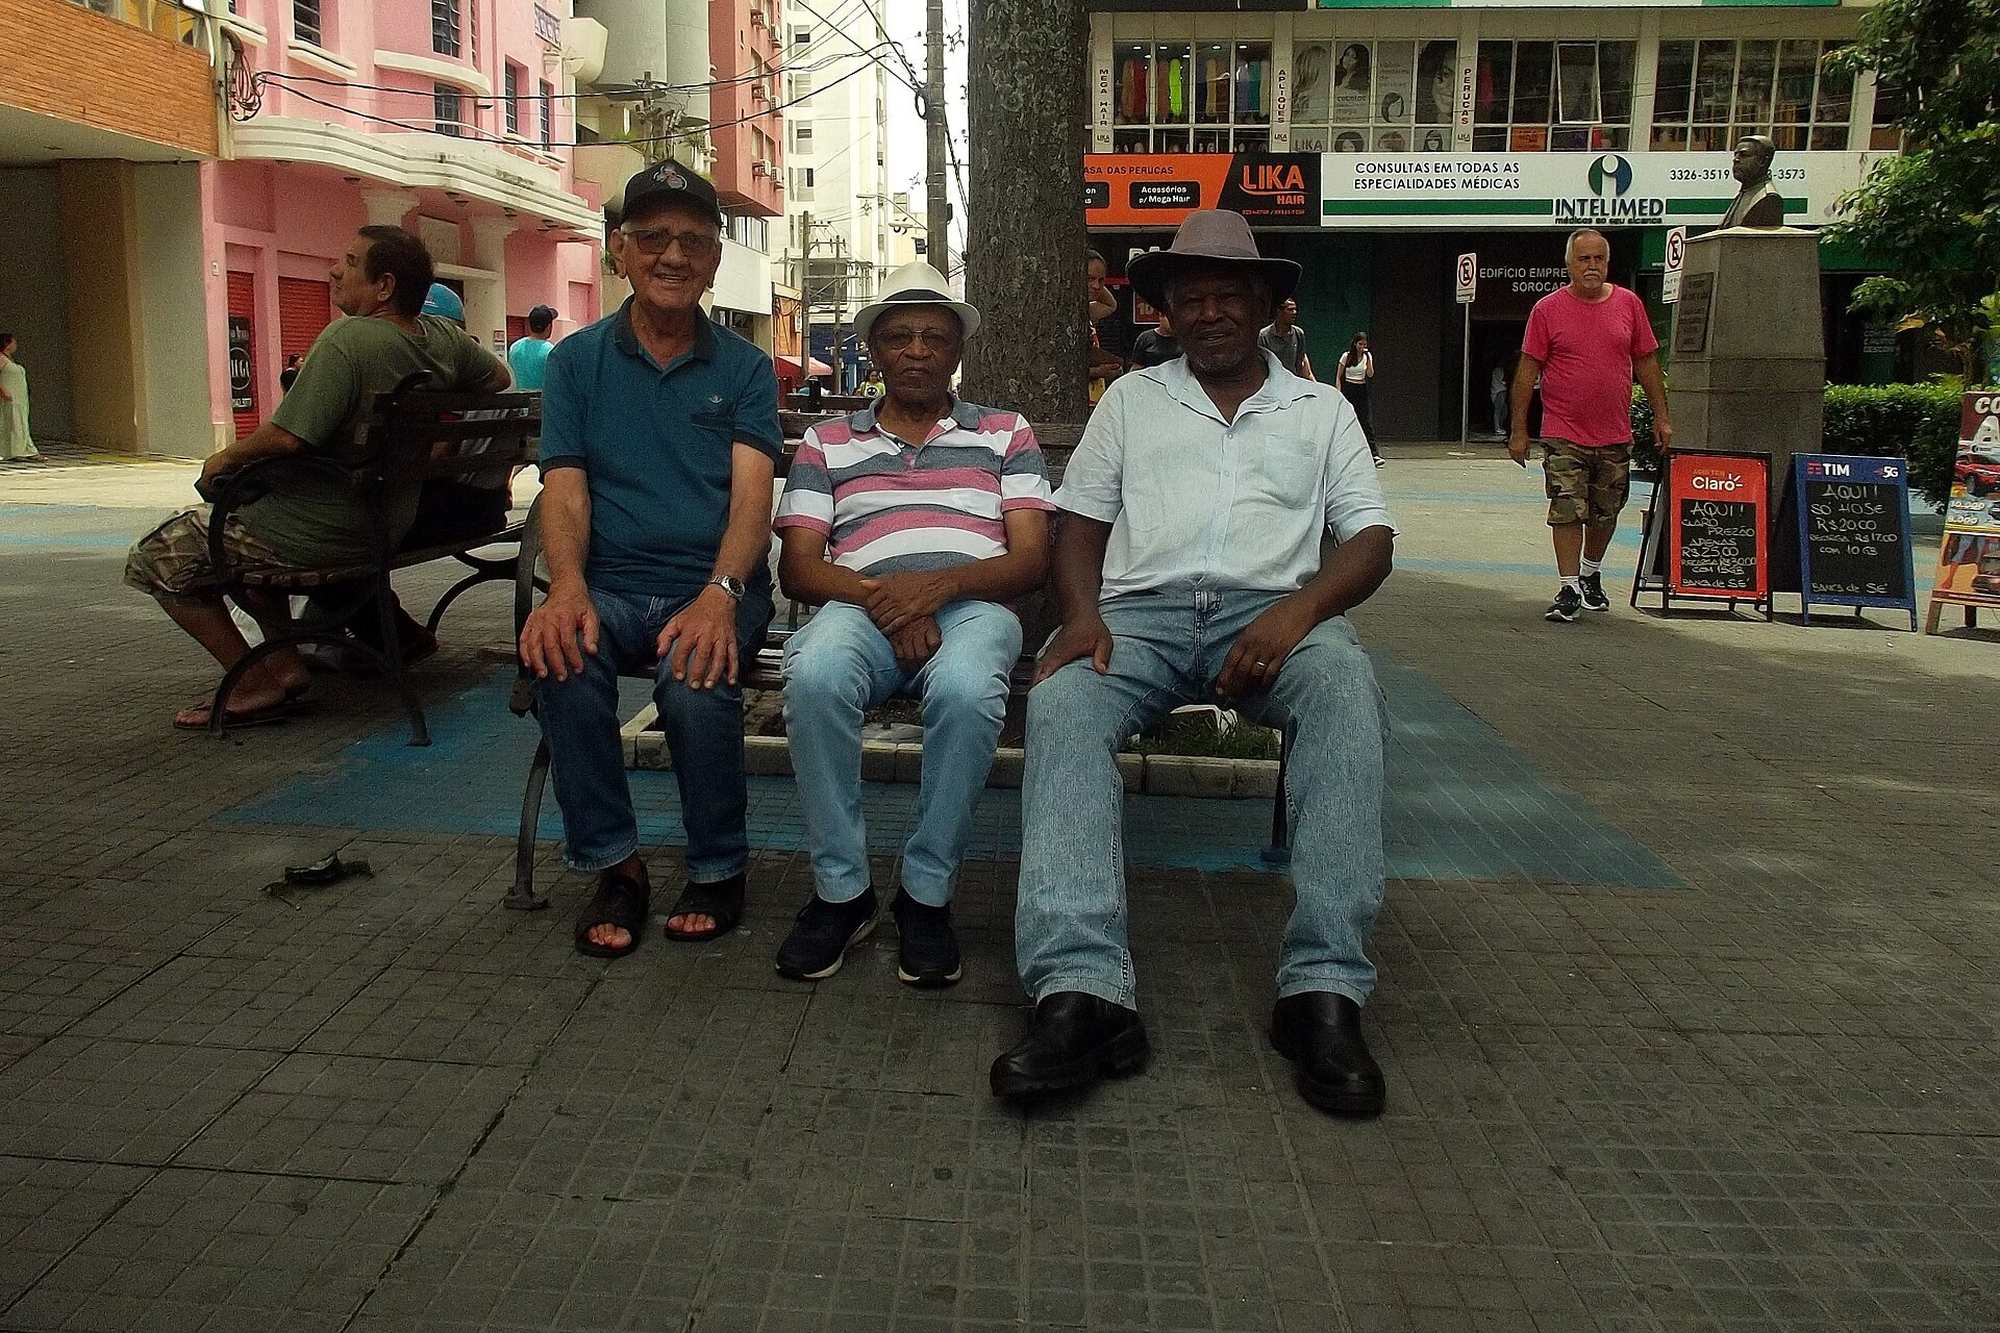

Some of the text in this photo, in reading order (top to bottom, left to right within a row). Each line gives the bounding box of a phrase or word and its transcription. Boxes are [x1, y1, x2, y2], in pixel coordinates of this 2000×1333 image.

[1099, 68, 1109, 126] MEGA HAIR
[1277, 69, 1287, 123] APLIQUES
[1461, 68, 1472, 124] PERUCAS
[1083, 166, 1174, 175] ASA DAS PERUCAS
[1355, 162, 1520, 174] CONSULTAS EM TODAS AS
[1670, 169, 1730, 180] 3326-3519
[1243, 164, 1305, 190] LIKA
[1354, 175, 1520, 190] ESPECIALIDADES MÉDICAS
[1276, 194, 1305, 206] HAIR
[1555, 198, 1664, 217] INTELIMED
[1479, 265, 1568, 278] EDIFÍCIO EMPRE
[1974, 396, 2000, 414] CO
[1823, 463, 1899, 478] TIM 5G
[1691, 475, 1736, 491] Claro
[1689, 538, 1737, 547] APENAS
